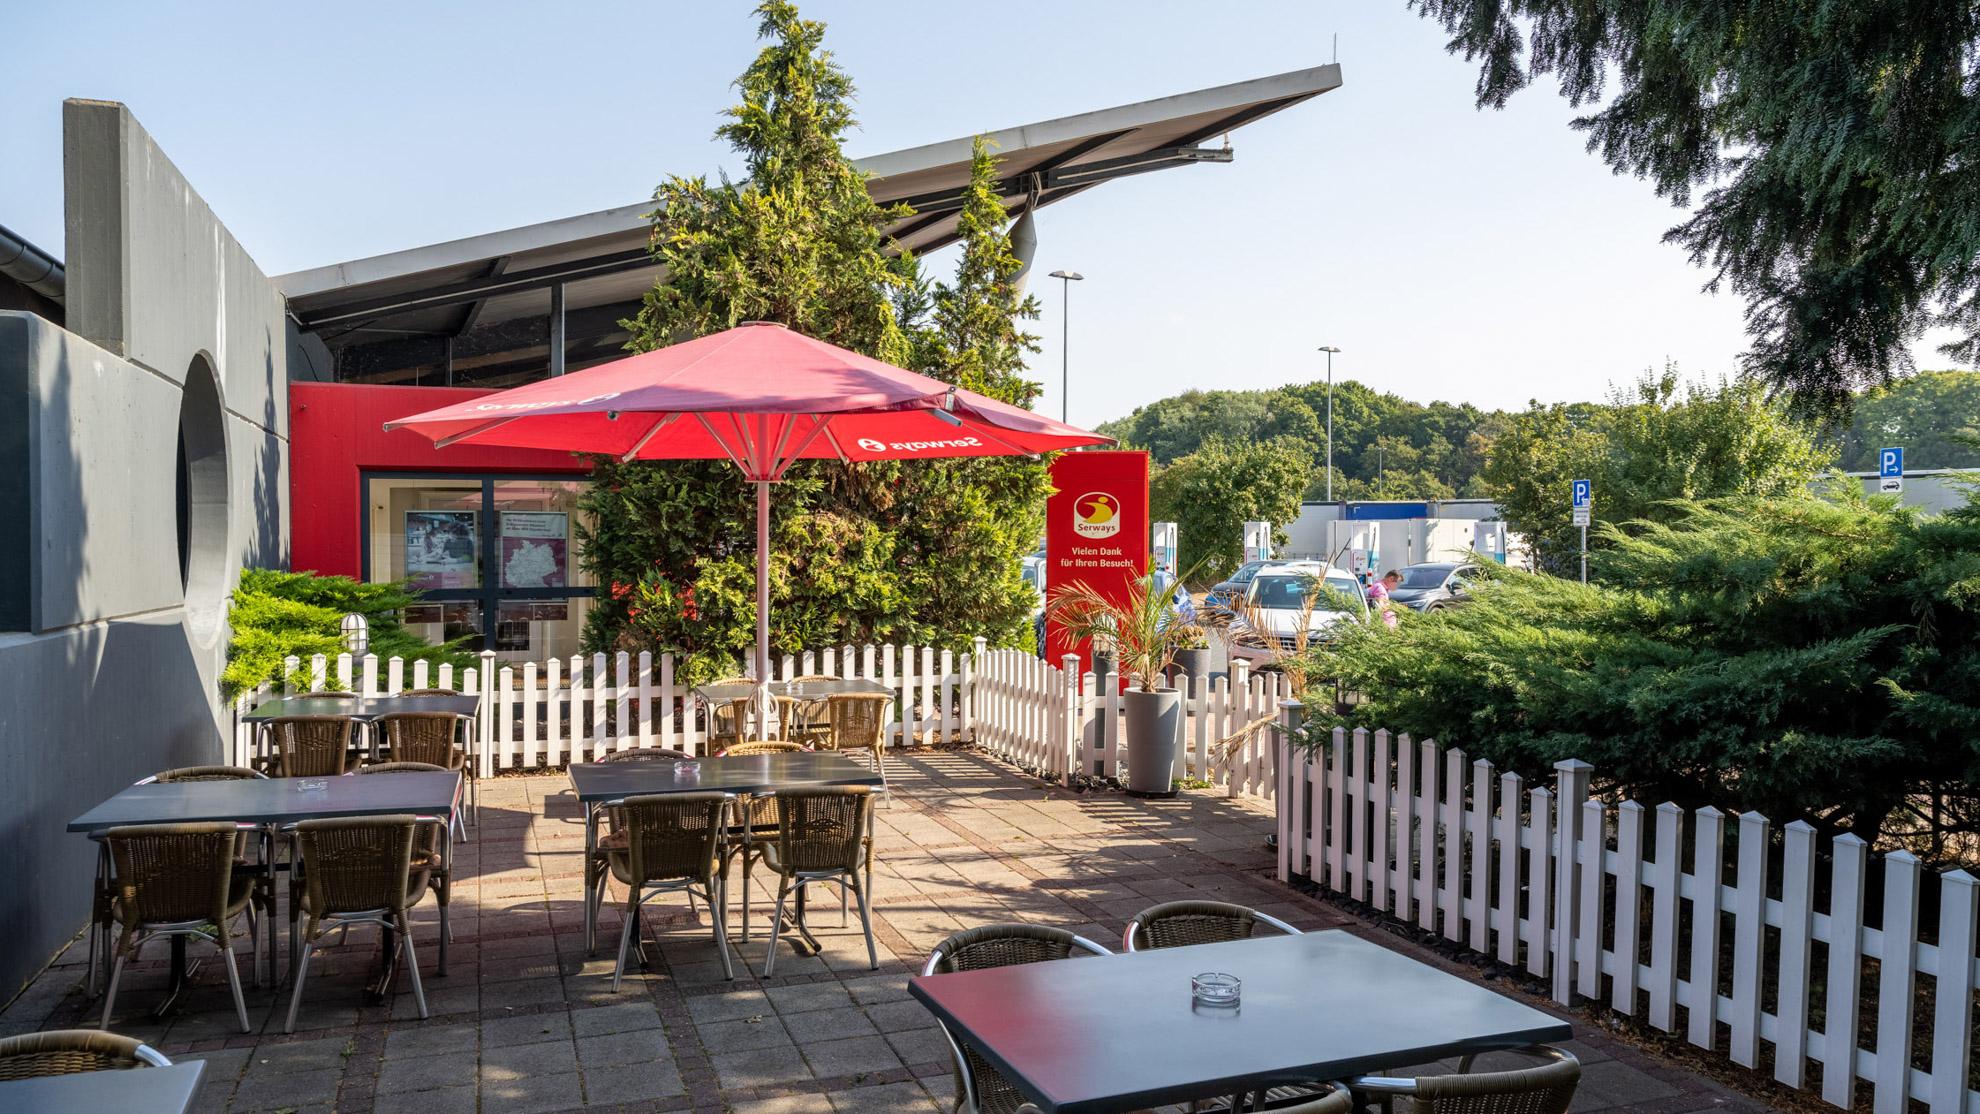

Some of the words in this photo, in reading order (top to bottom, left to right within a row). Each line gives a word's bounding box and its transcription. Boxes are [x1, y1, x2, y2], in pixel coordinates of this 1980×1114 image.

[1884, 452, 1896, 473] P
[1576, 483, 1586, 504] P
[1078, 523, 1116, 533] Serways
[1071, 547, 1098, 556] Vielen
[1100, 547, 1122, 556] Dank
[1060, 558, 1073, 567] für
[1075, 558, 1098, 567] Ihren
[1100, 559, 1134, 568] Besuch!
